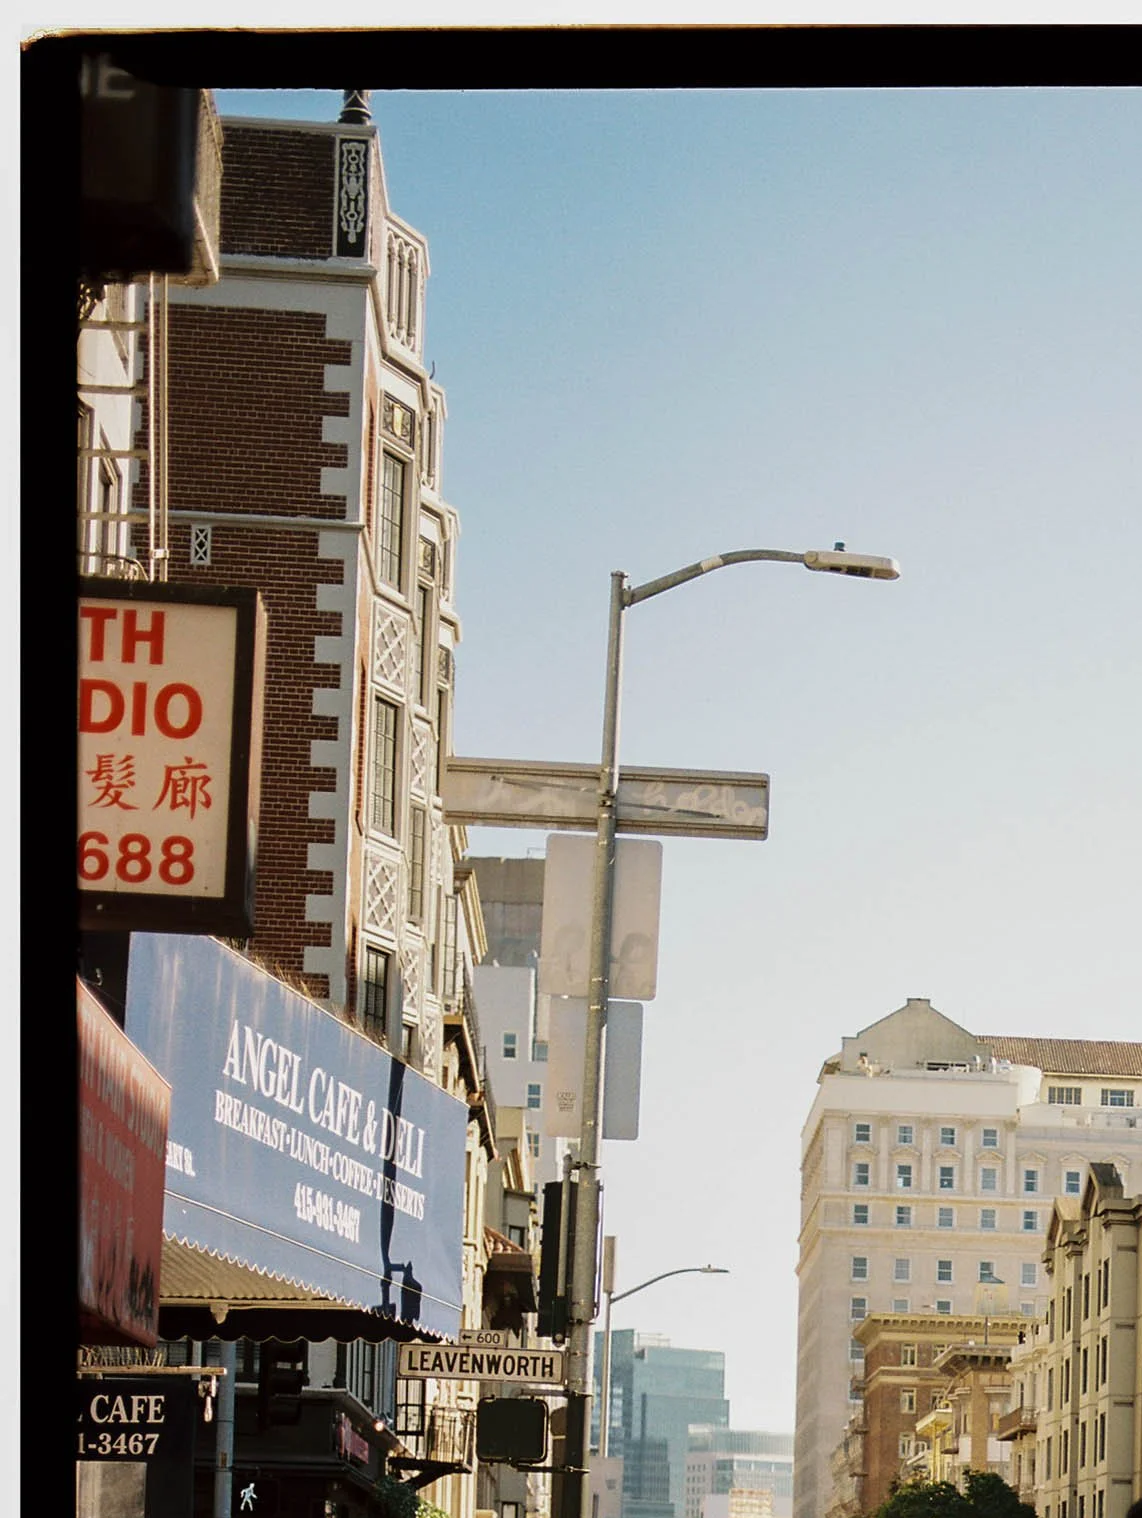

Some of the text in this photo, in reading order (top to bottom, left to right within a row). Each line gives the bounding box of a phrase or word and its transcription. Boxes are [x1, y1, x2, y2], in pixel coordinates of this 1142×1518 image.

[80, 606, 166, 665] TH
[79, 678, 204, 739] DIO
[86, 753, 212, 820] 髮廊
[79, 831, 195, 886] 688
[222, 1019, 426, 1179] ANGEL CAFE & DELI
[214, 1088, 426, 1222] BREAKFAST LUNCH COFFEE DESSERTS
[408, 1351, 554, 1378] LEAVENWORTH
[477, 1332, 500, 1345] 600
[90, 1394, 166, 1424] CAFE
